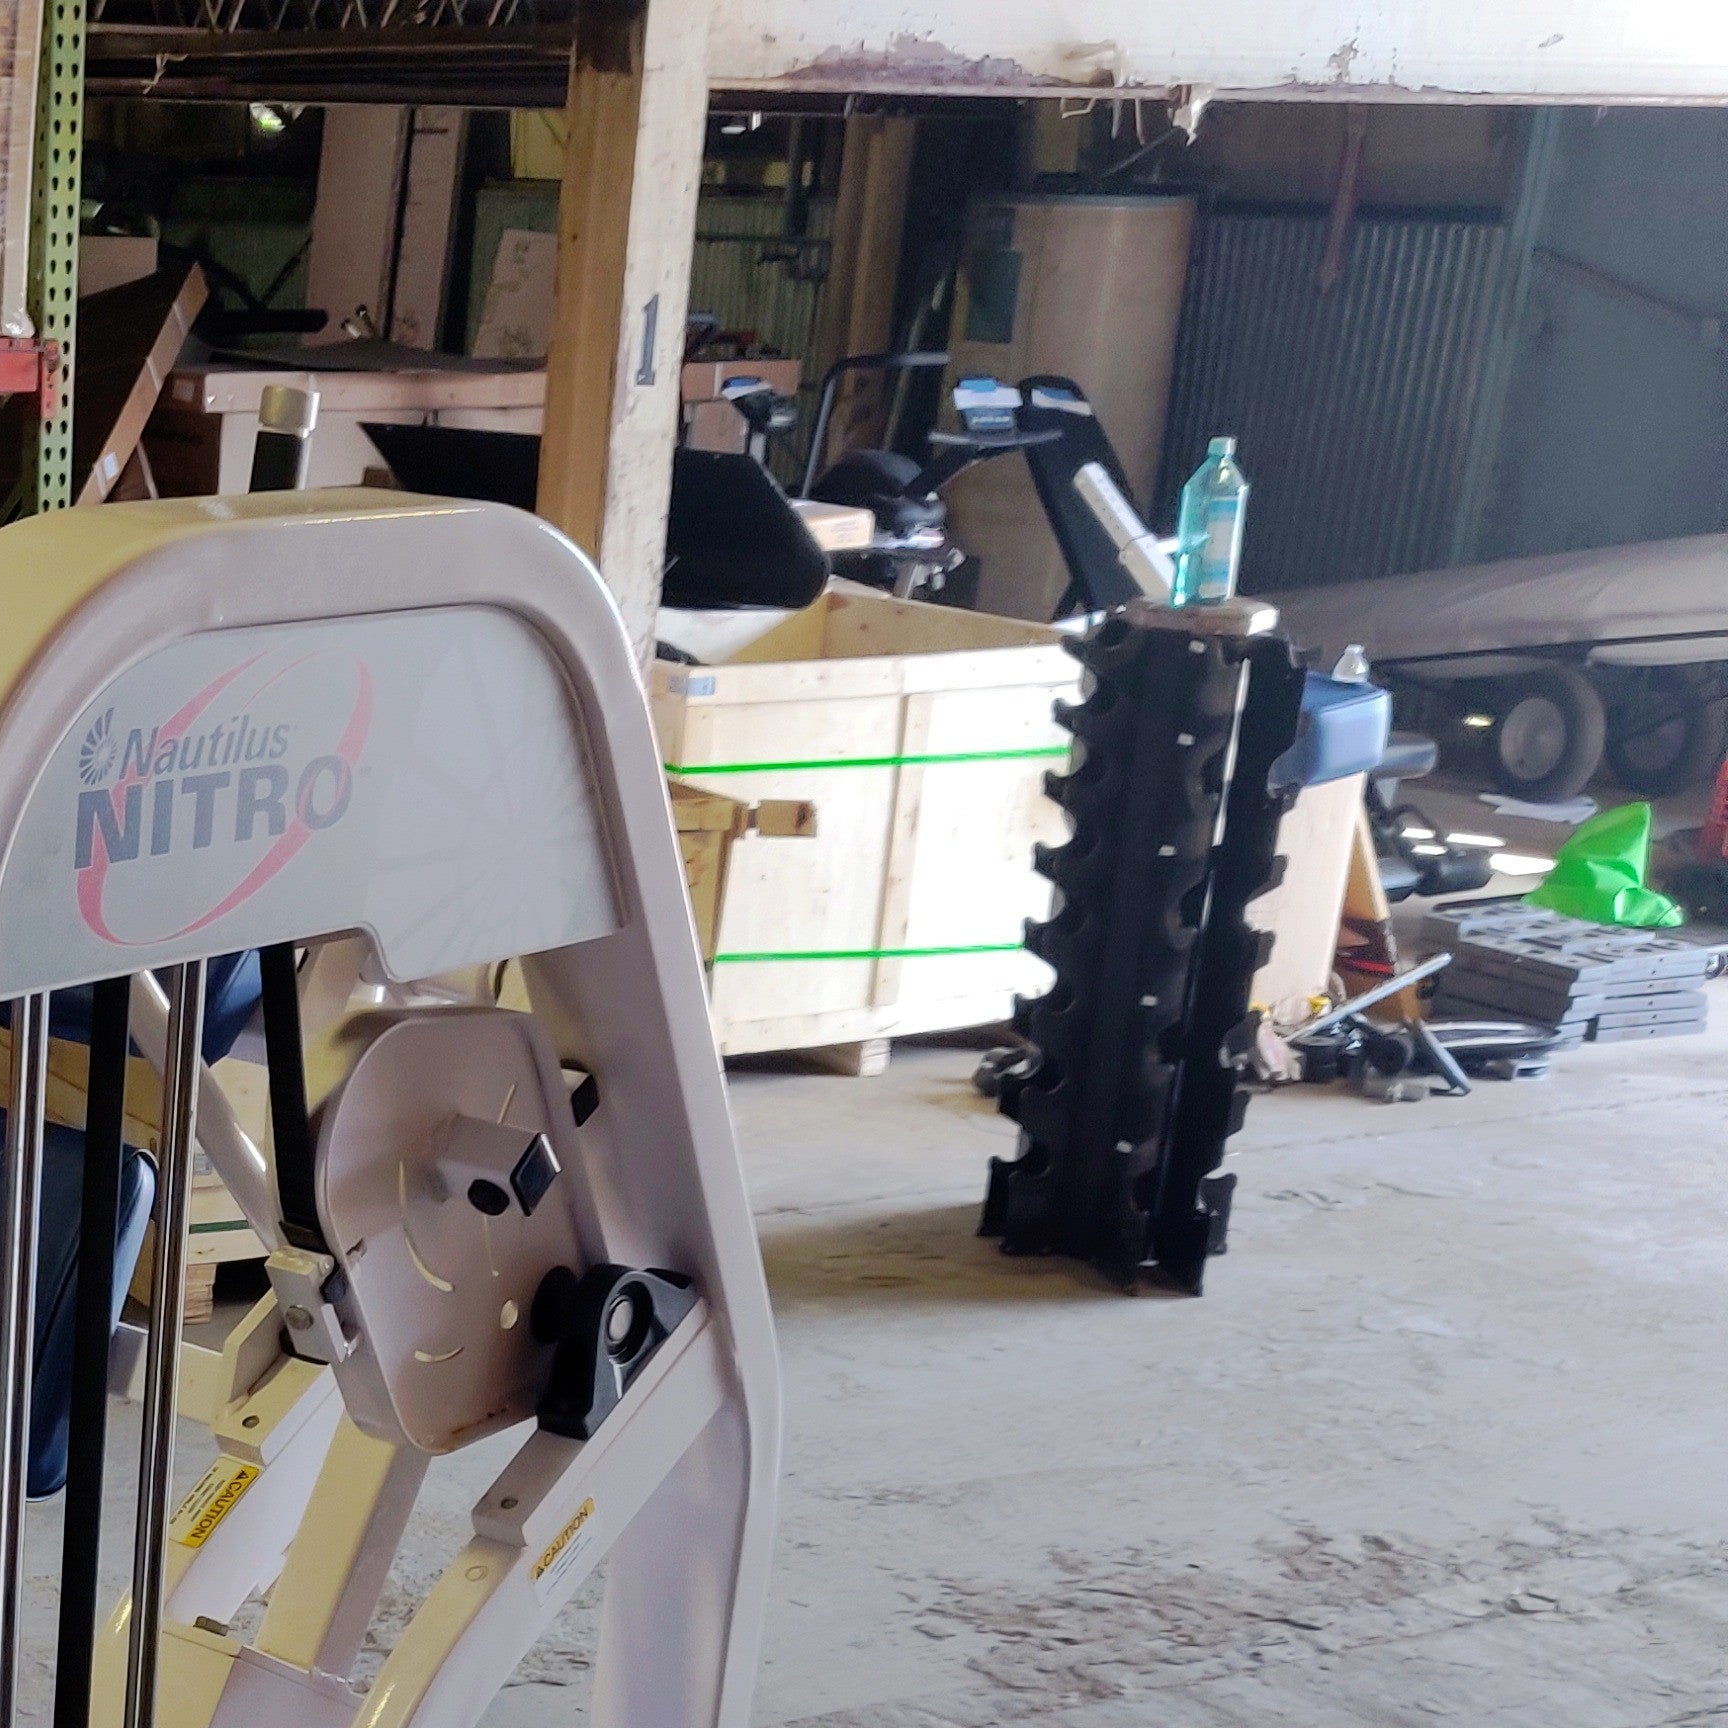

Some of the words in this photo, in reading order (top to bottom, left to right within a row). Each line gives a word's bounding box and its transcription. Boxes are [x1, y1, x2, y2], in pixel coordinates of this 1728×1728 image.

[636, 293, 659, 386] 1
[118, 714, 290, 781] Nautilus
[73, 753, 353, 871] NITRO
[191, 1481, 243, 1539] CAUTION
[544, 1506, 588, 1567] CAUTION
